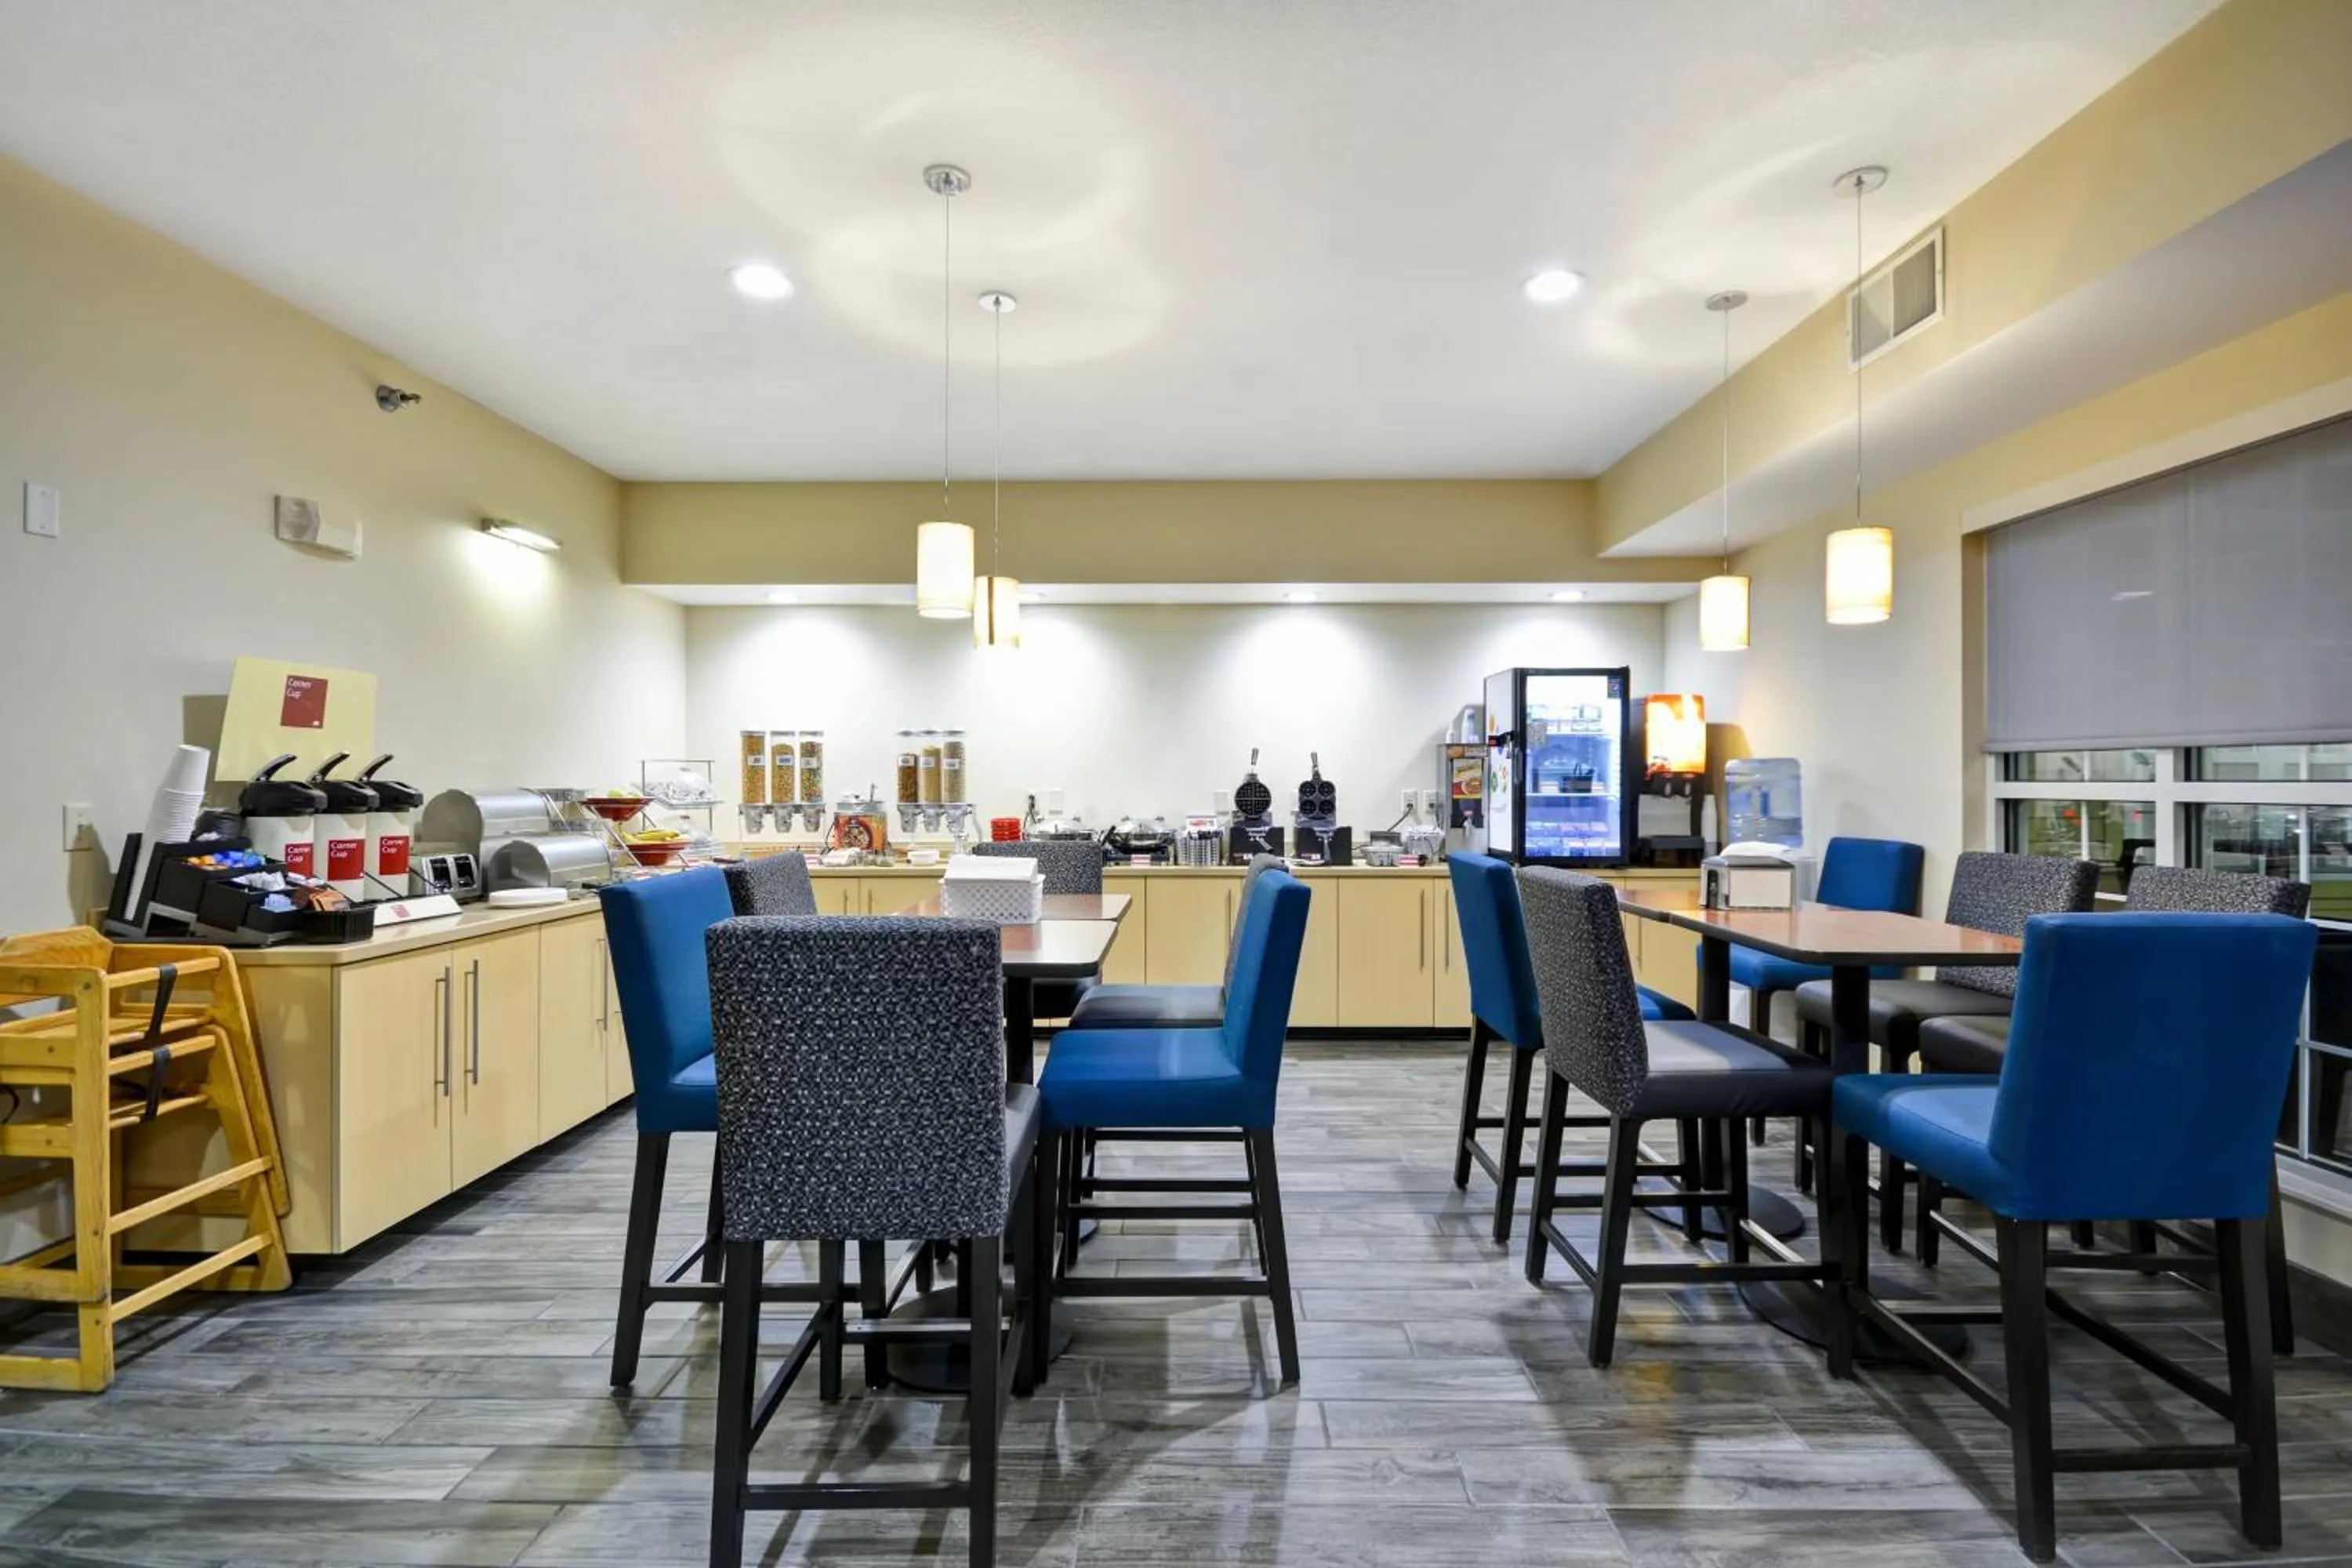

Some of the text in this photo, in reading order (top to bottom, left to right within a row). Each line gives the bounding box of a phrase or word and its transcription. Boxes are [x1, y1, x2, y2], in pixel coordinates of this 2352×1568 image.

[288, 677, 312, 689] Corner
[287, 688, 302, 700] Cup
[331, 841, 358, 850] Corner
[288, 854, 304, 862] Cup
[330, 850, 348, 858] Cup
